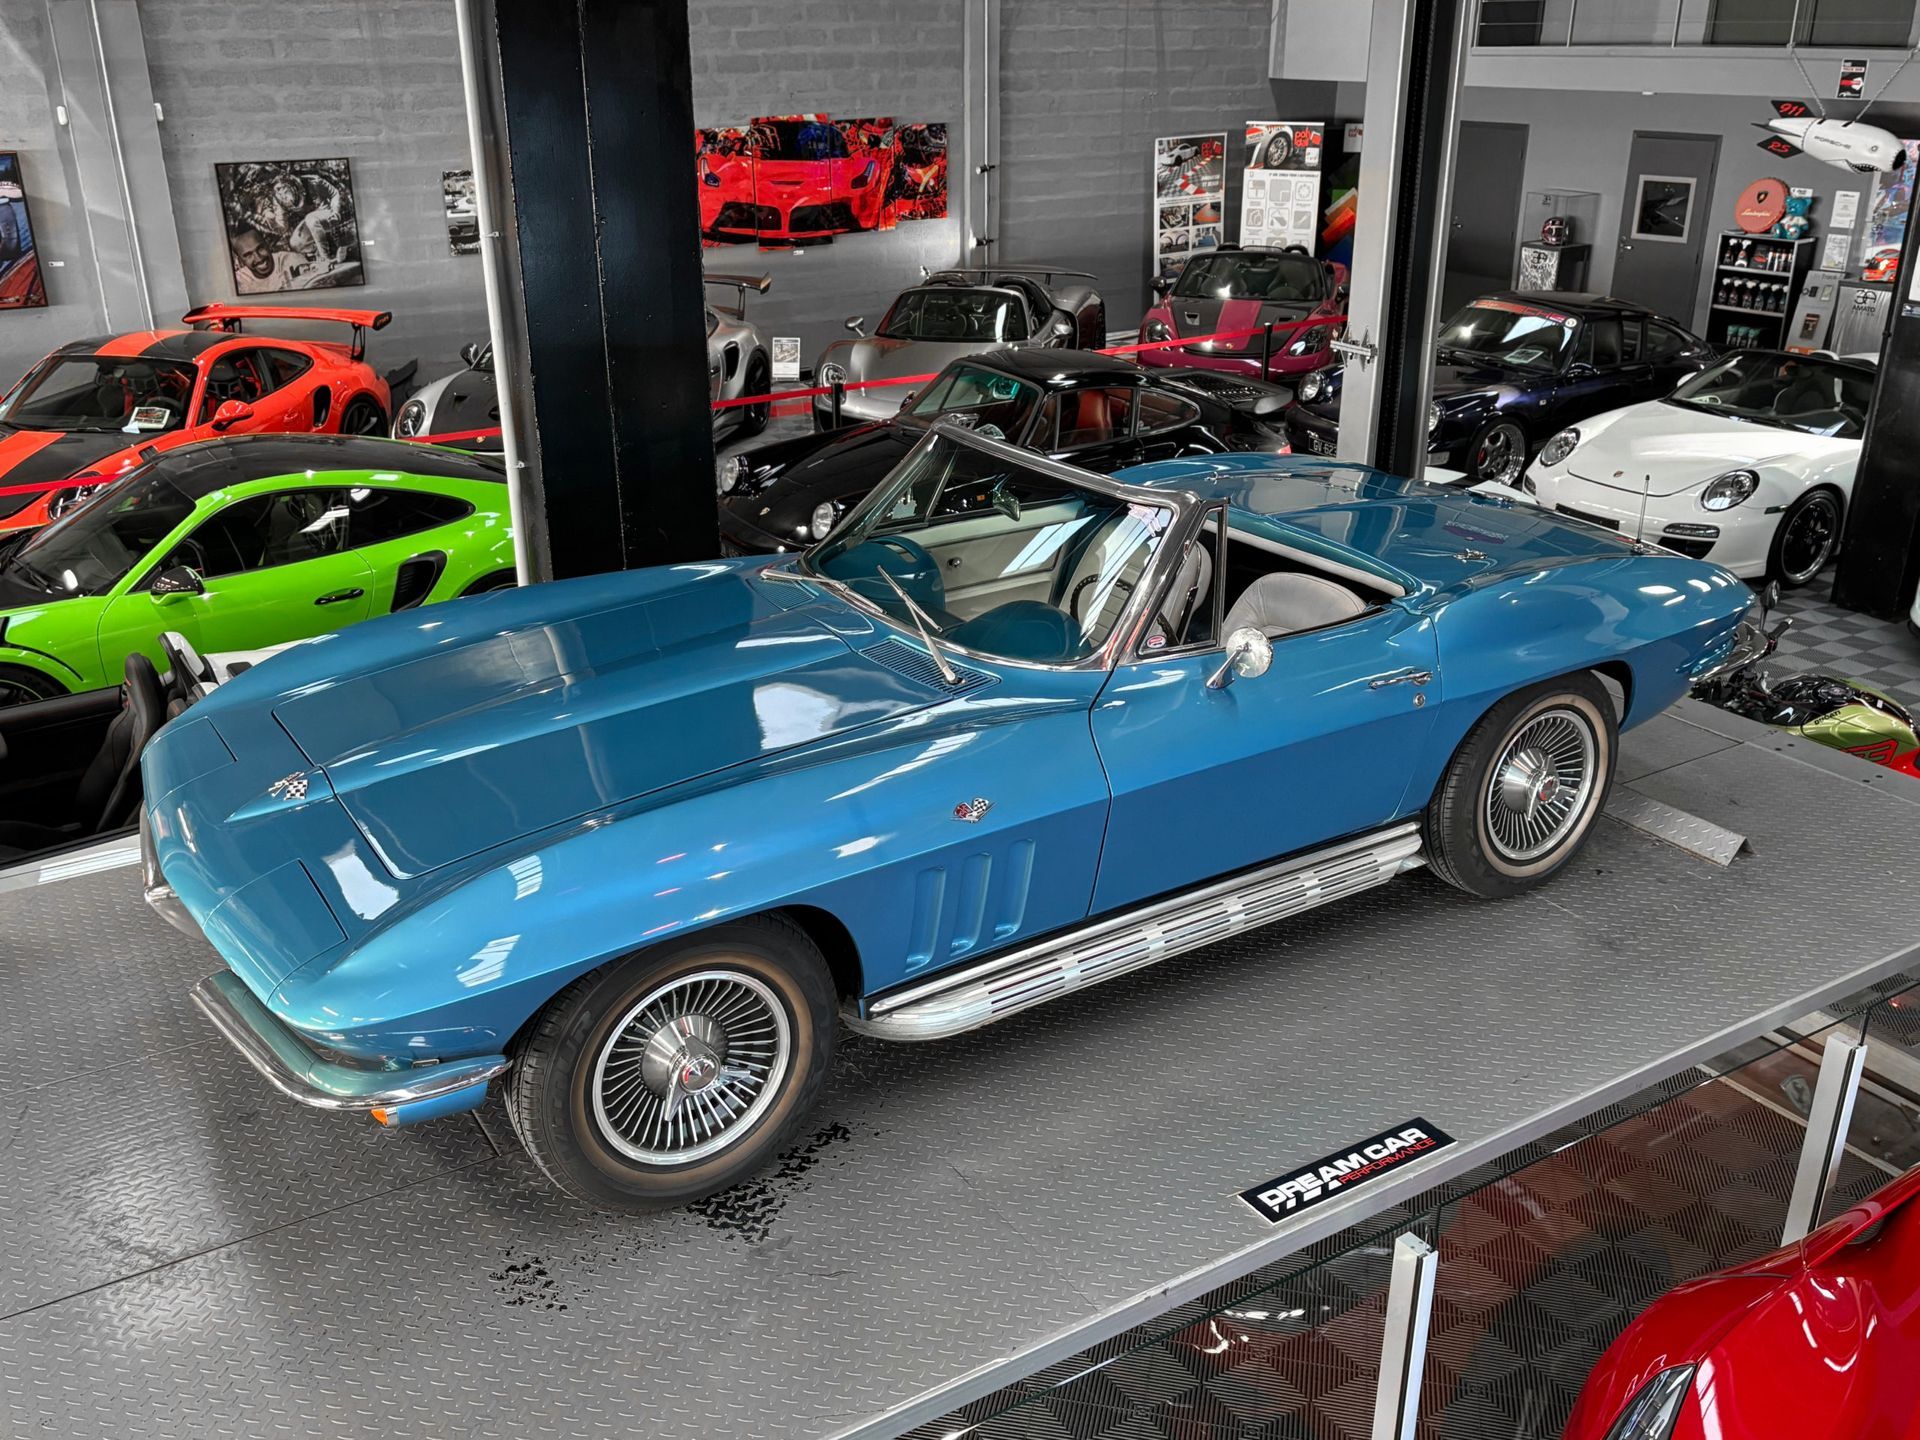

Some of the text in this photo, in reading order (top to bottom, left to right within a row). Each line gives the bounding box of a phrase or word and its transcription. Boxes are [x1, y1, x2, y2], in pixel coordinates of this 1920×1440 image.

[1779, 103, 1805, 116] 911
[1256, 1127, 1429, 1208] DREAM CAR
[1338, 1137, 1436, 1184] PERFORMANCE
